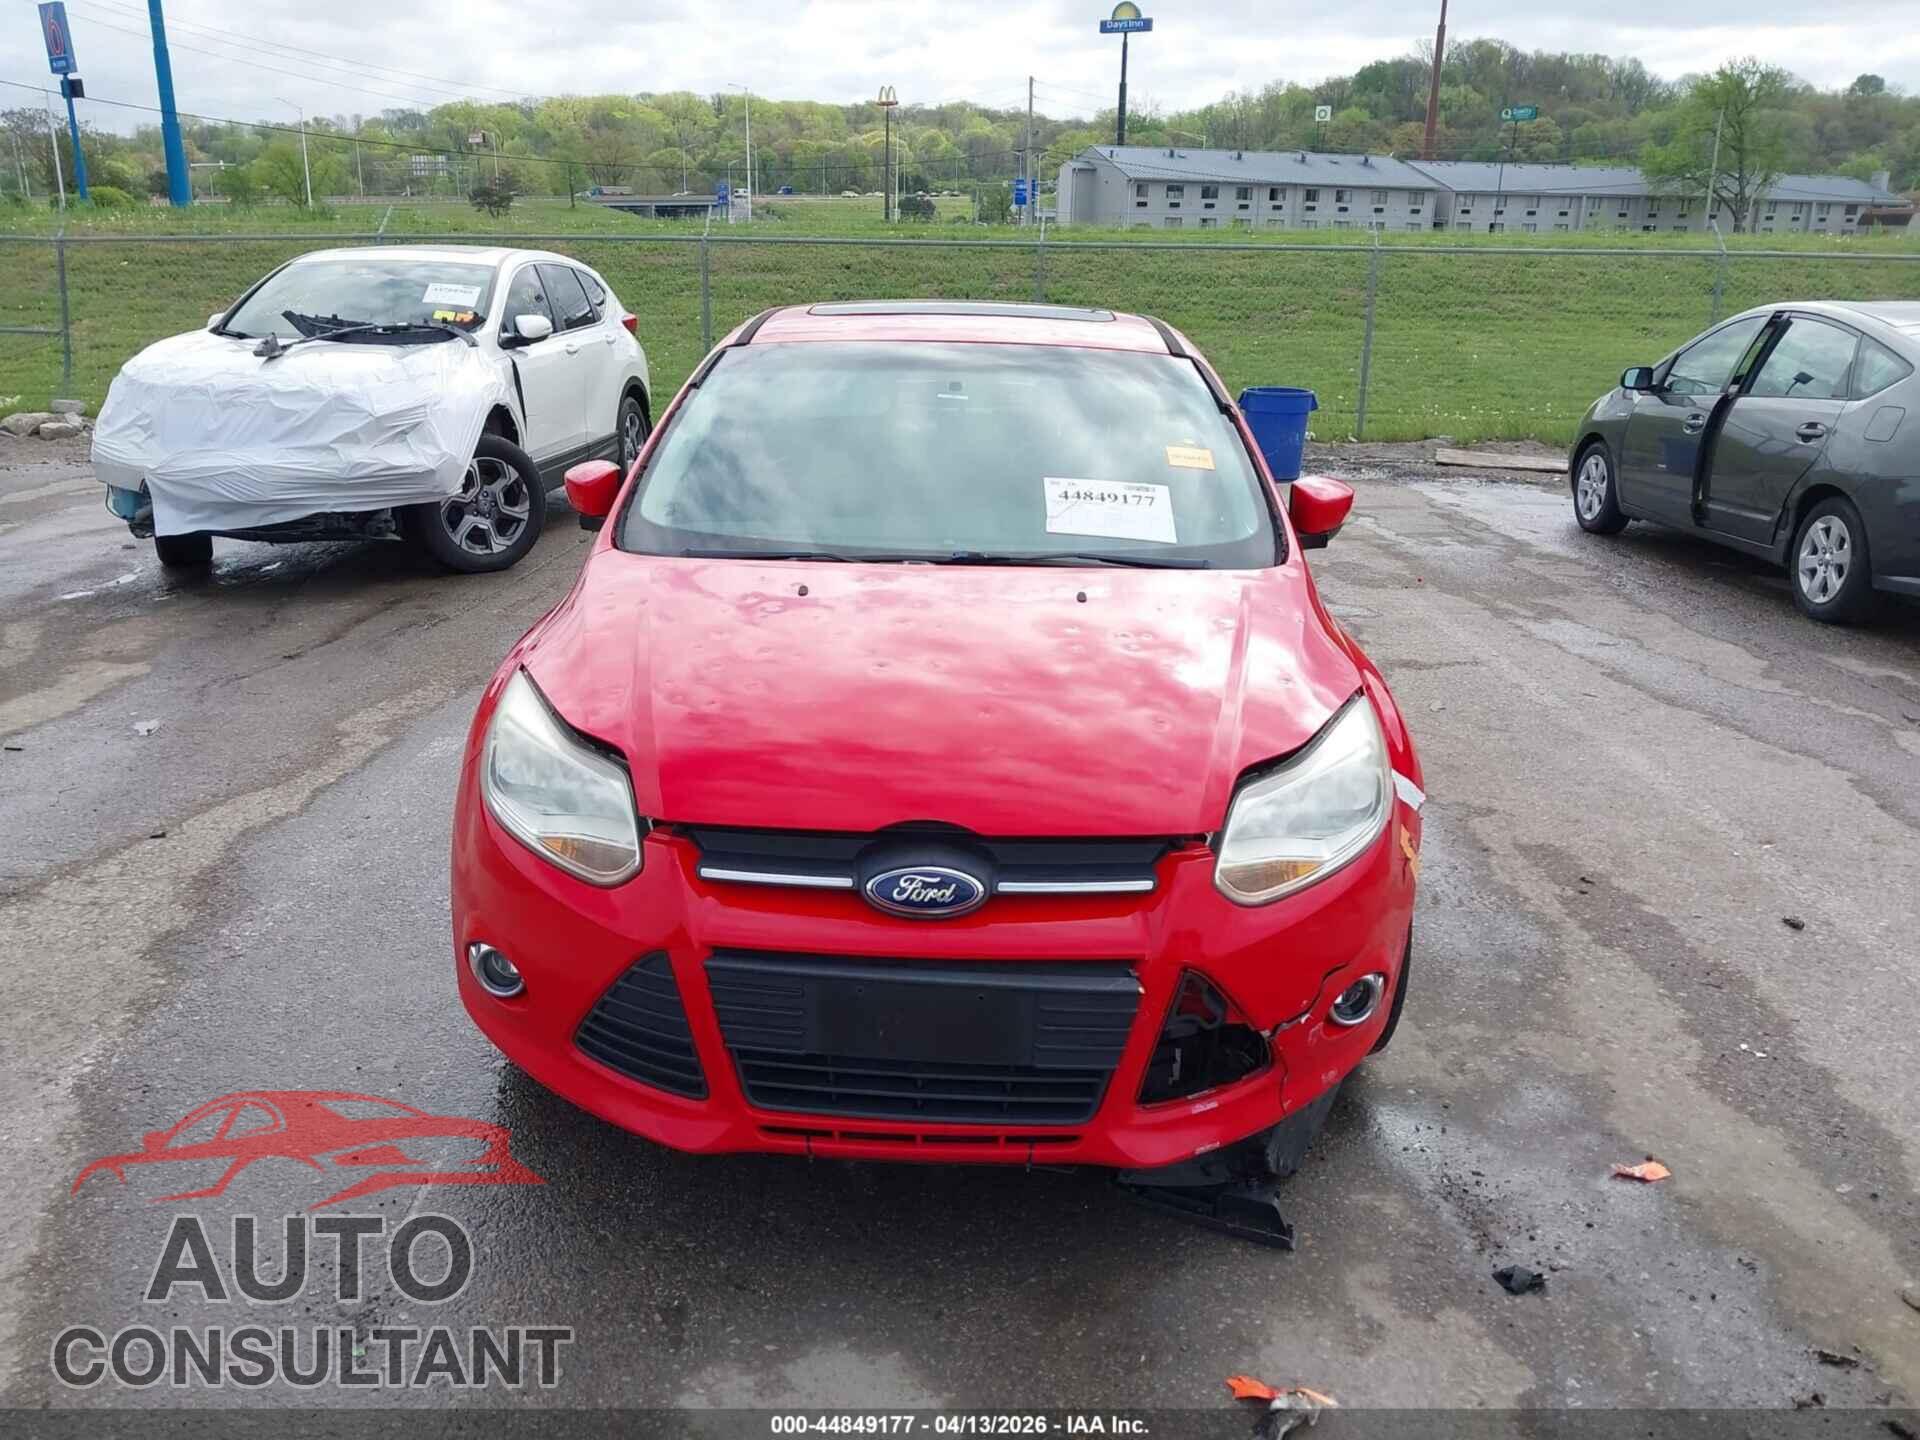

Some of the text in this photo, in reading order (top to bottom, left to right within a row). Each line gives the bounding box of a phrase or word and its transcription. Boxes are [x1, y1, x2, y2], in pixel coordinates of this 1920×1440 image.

[1106, 21, 1128, 30] Days
[1128, 20, 1144, 28] Inn
[1058, 489, 1156, 507] 44849177
[892, 874, 957, 903] Ford
